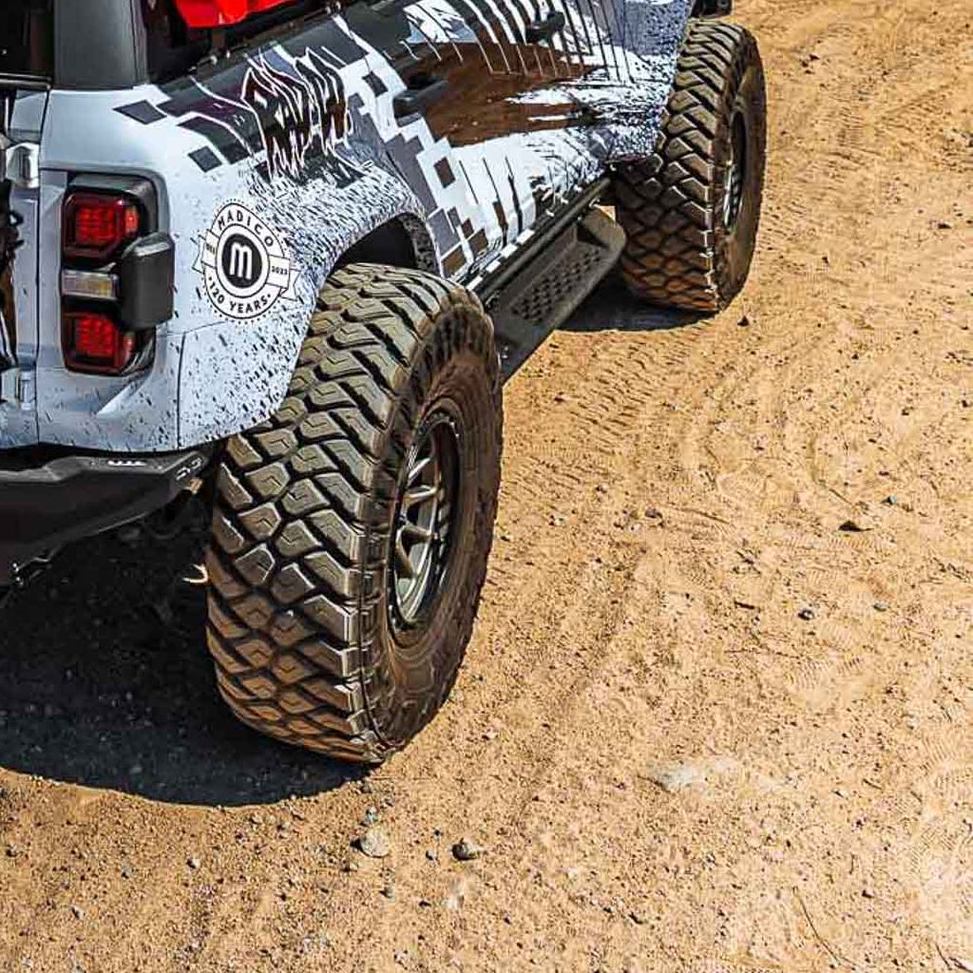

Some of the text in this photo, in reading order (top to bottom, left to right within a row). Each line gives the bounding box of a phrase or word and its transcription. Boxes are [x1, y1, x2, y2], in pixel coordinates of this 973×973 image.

[218, 210, 274, 247] MADICO
[209, 282, 268, 314] 120 YEARS
